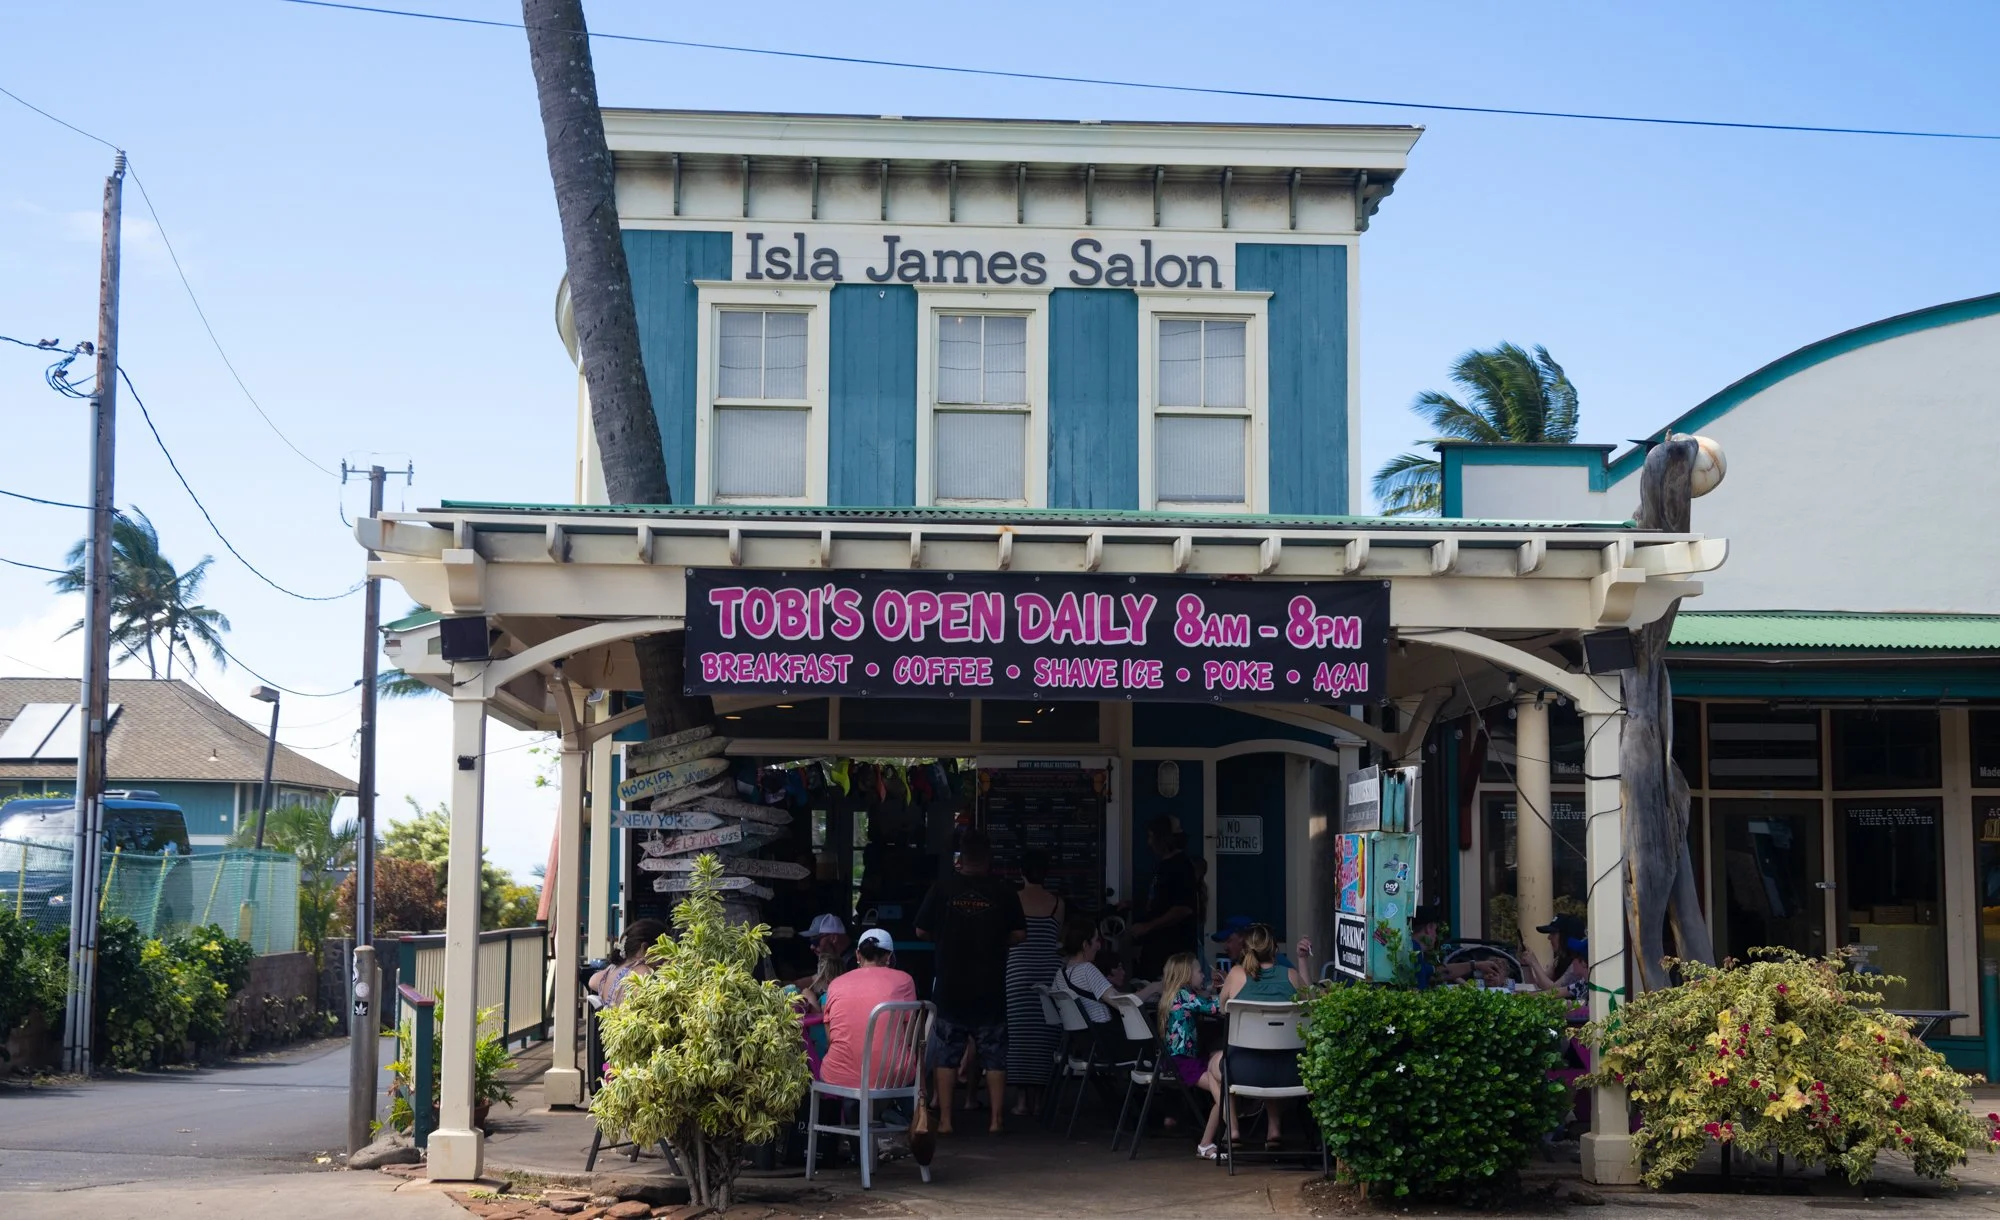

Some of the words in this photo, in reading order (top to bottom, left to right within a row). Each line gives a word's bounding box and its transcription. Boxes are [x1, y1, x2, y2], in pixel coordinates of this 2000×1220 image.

[746, 232, 843, 281] Isla
[866, 235, 1047, 286] James
[1069, 238, 1223, 288] Salon
[709, 583, 865, 640] TOBI'S
[873, 589, 1004, 643] OPEN
[1015, 592, 1157, 645] DAILY
[1174, 593, 1250, 648] 8AM
[1286, 595, 1362, 649] 8PM
[701, 652, 853, 684] BREAKFAST
[893, 655, 993, 686] COFFEE
[1034, 657, 1118, 688] SHAVE
[1123, 659, 1163, 689] ICE
[1204, 661, 1274, 690] POKE
[1314, 662, 1368, 698] AÇAI
[621, 812, 654, 826] NEW
[656, 812, 695, 828] YORK
[1848, 808, 1883, 818] WHERE
[1886, 808, 1918, 817] COLOR
[1859, 817, 1894, 825] MEETS
[1896, 816, 1934, 825] WATER
[1227, 820, 1240, 833] NO
[1216, 835, 1258, 849] OITERING
[1340, 923, 1364, 952] PARKING
